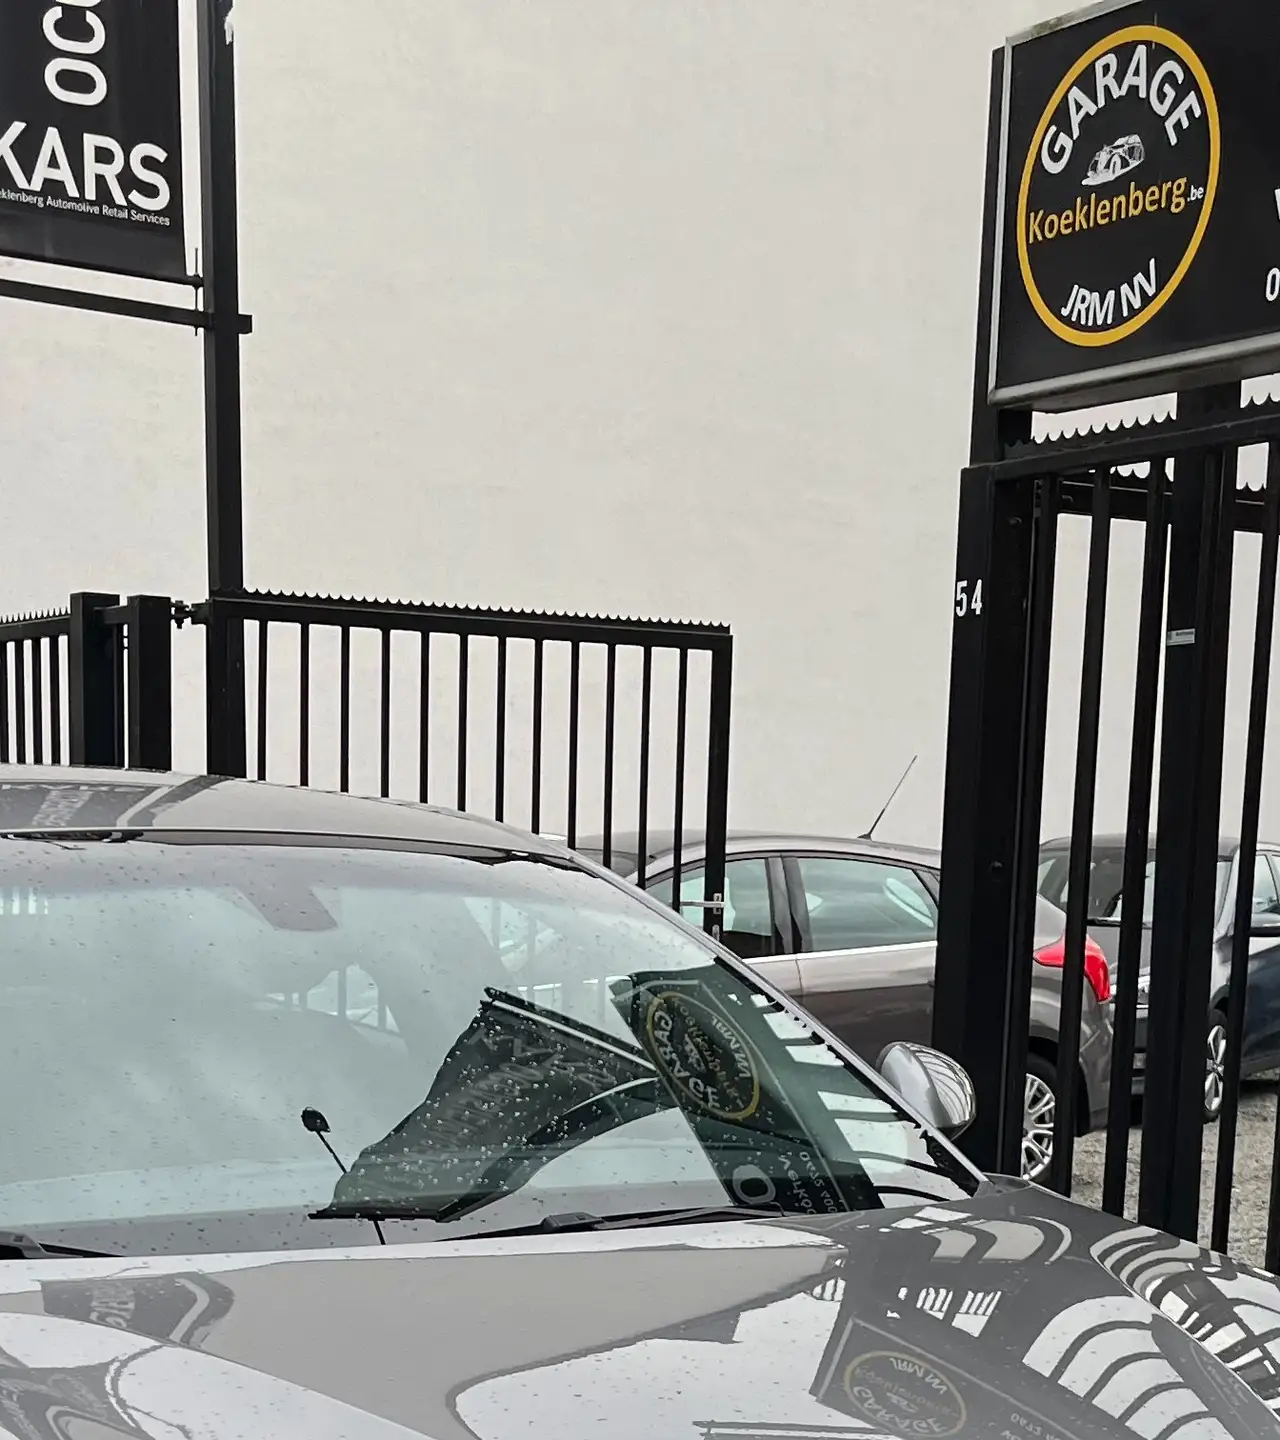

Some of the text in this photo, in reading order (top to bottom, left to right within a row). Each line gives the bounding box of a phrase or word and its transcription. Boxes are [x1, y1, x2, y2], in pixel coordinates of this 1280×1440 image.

[42, 0, 107, 106] OC
[1040, 44, 1201, 176] GARAGE
[102, 205, 128, 219] Retail
[130, 210, 171, 226] Services
[1061, 258, 1158, 327] JRM NV
[955, 578, 983, 617] 54
